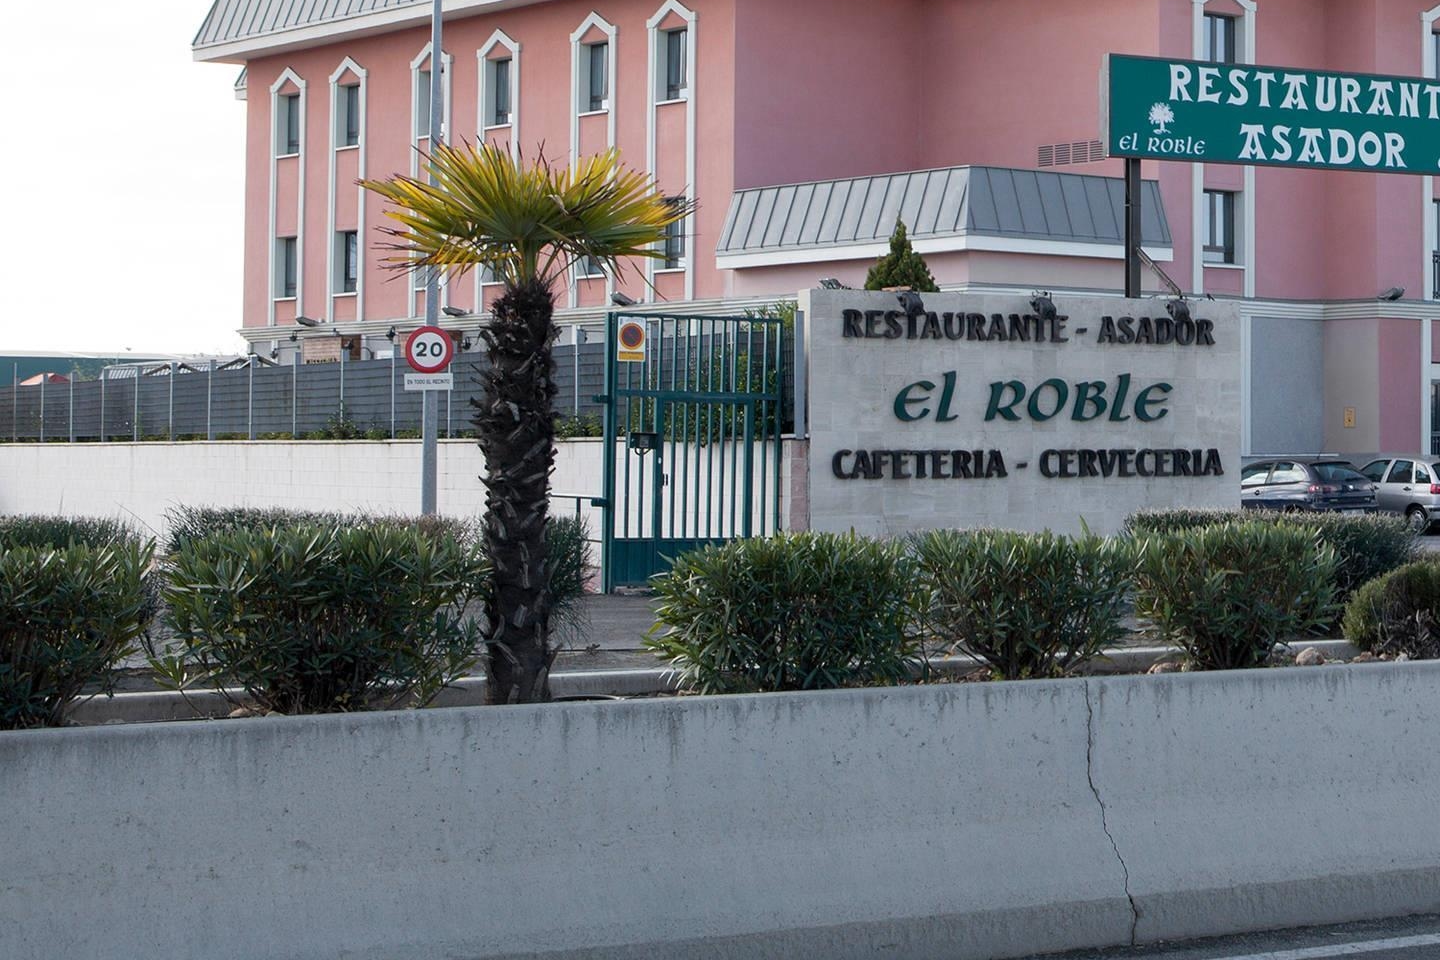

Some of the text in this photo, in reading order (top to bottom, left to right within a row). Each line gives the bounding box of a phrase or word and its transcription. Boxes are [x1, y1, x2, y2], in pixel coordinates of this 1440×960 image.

[1237, 123, 1409, 168] ASADOR
[842, 308, 1070, 343] RESTAURANTE
[1097, 315, 1216, 346] ASADOR
[415, 341, 443, 357] 20
[832, 448, 1009, 480] CAFETERIA
[1039, 447, 1225, 478] CERVECERIA
